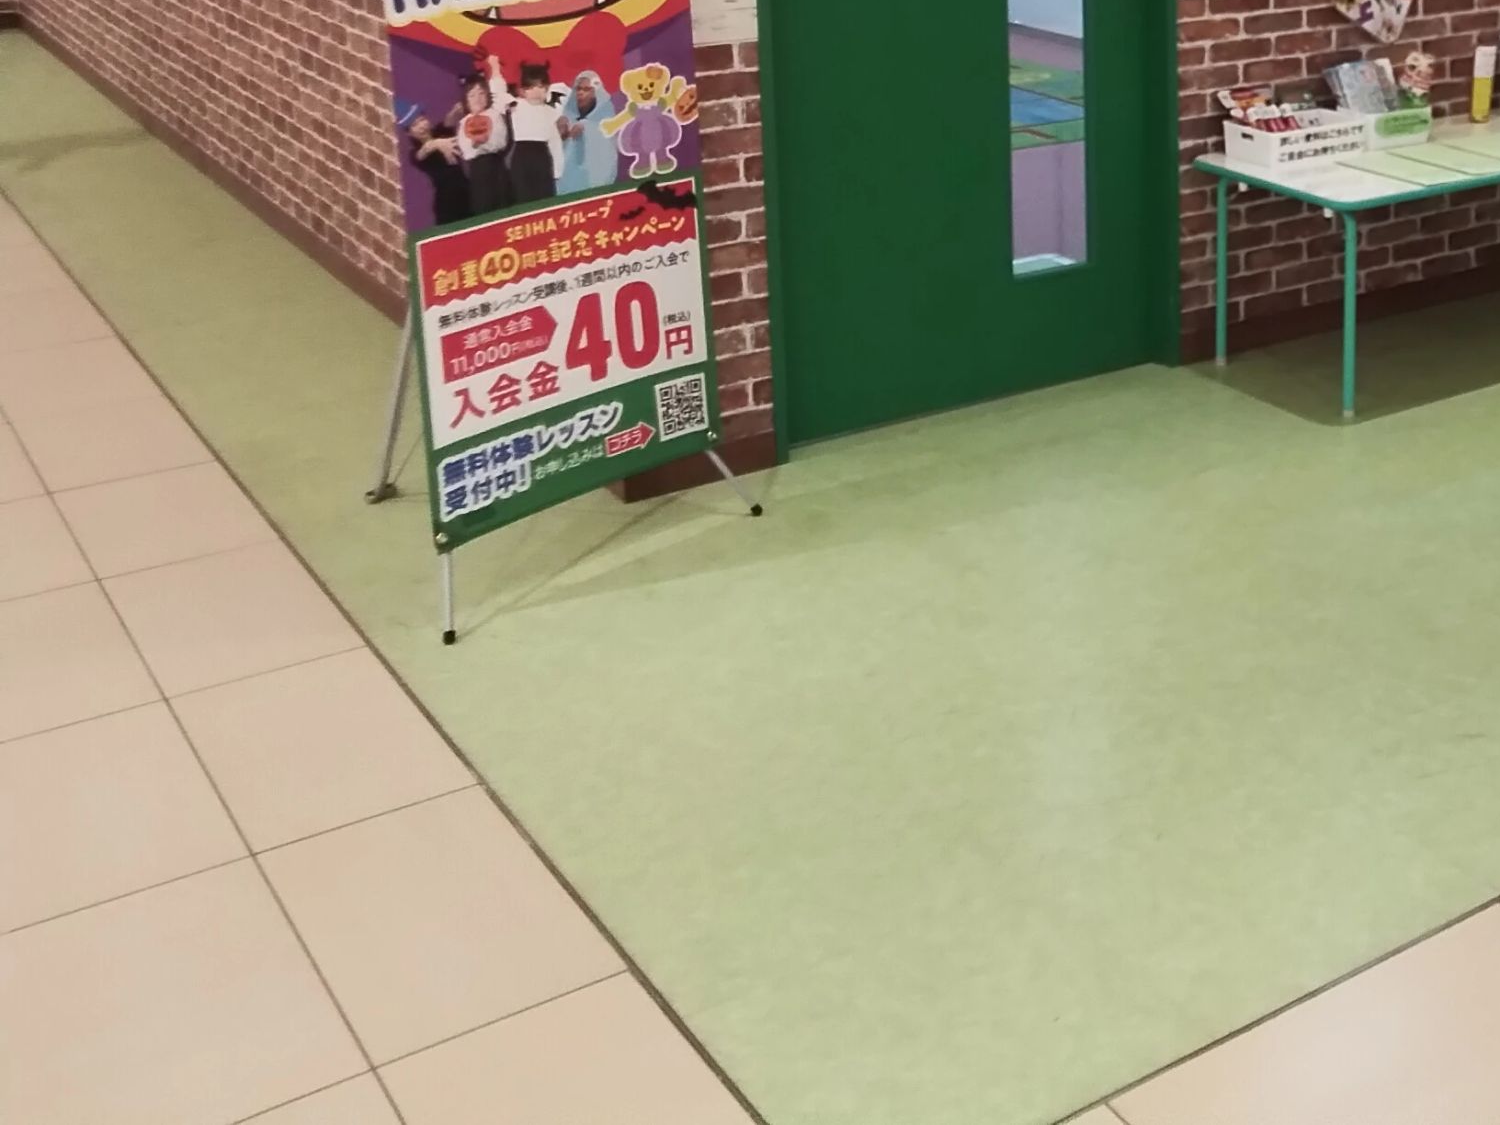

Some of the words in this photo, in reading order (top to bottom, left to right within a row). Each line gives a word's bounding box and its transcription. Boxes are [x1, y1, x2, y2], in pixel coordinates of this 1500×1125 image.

[506, 200, 614, 243] SEIHAグループ
[432, 215, 686, 297] 創業40周年記念キャンペーン
[450, 360, 561, 429] 入会金
[443, 405, 620, 484] 無料体験レッスン
[609, 428, 645, 454] コチラ
[443, 465, 529, 515] 受付中！
